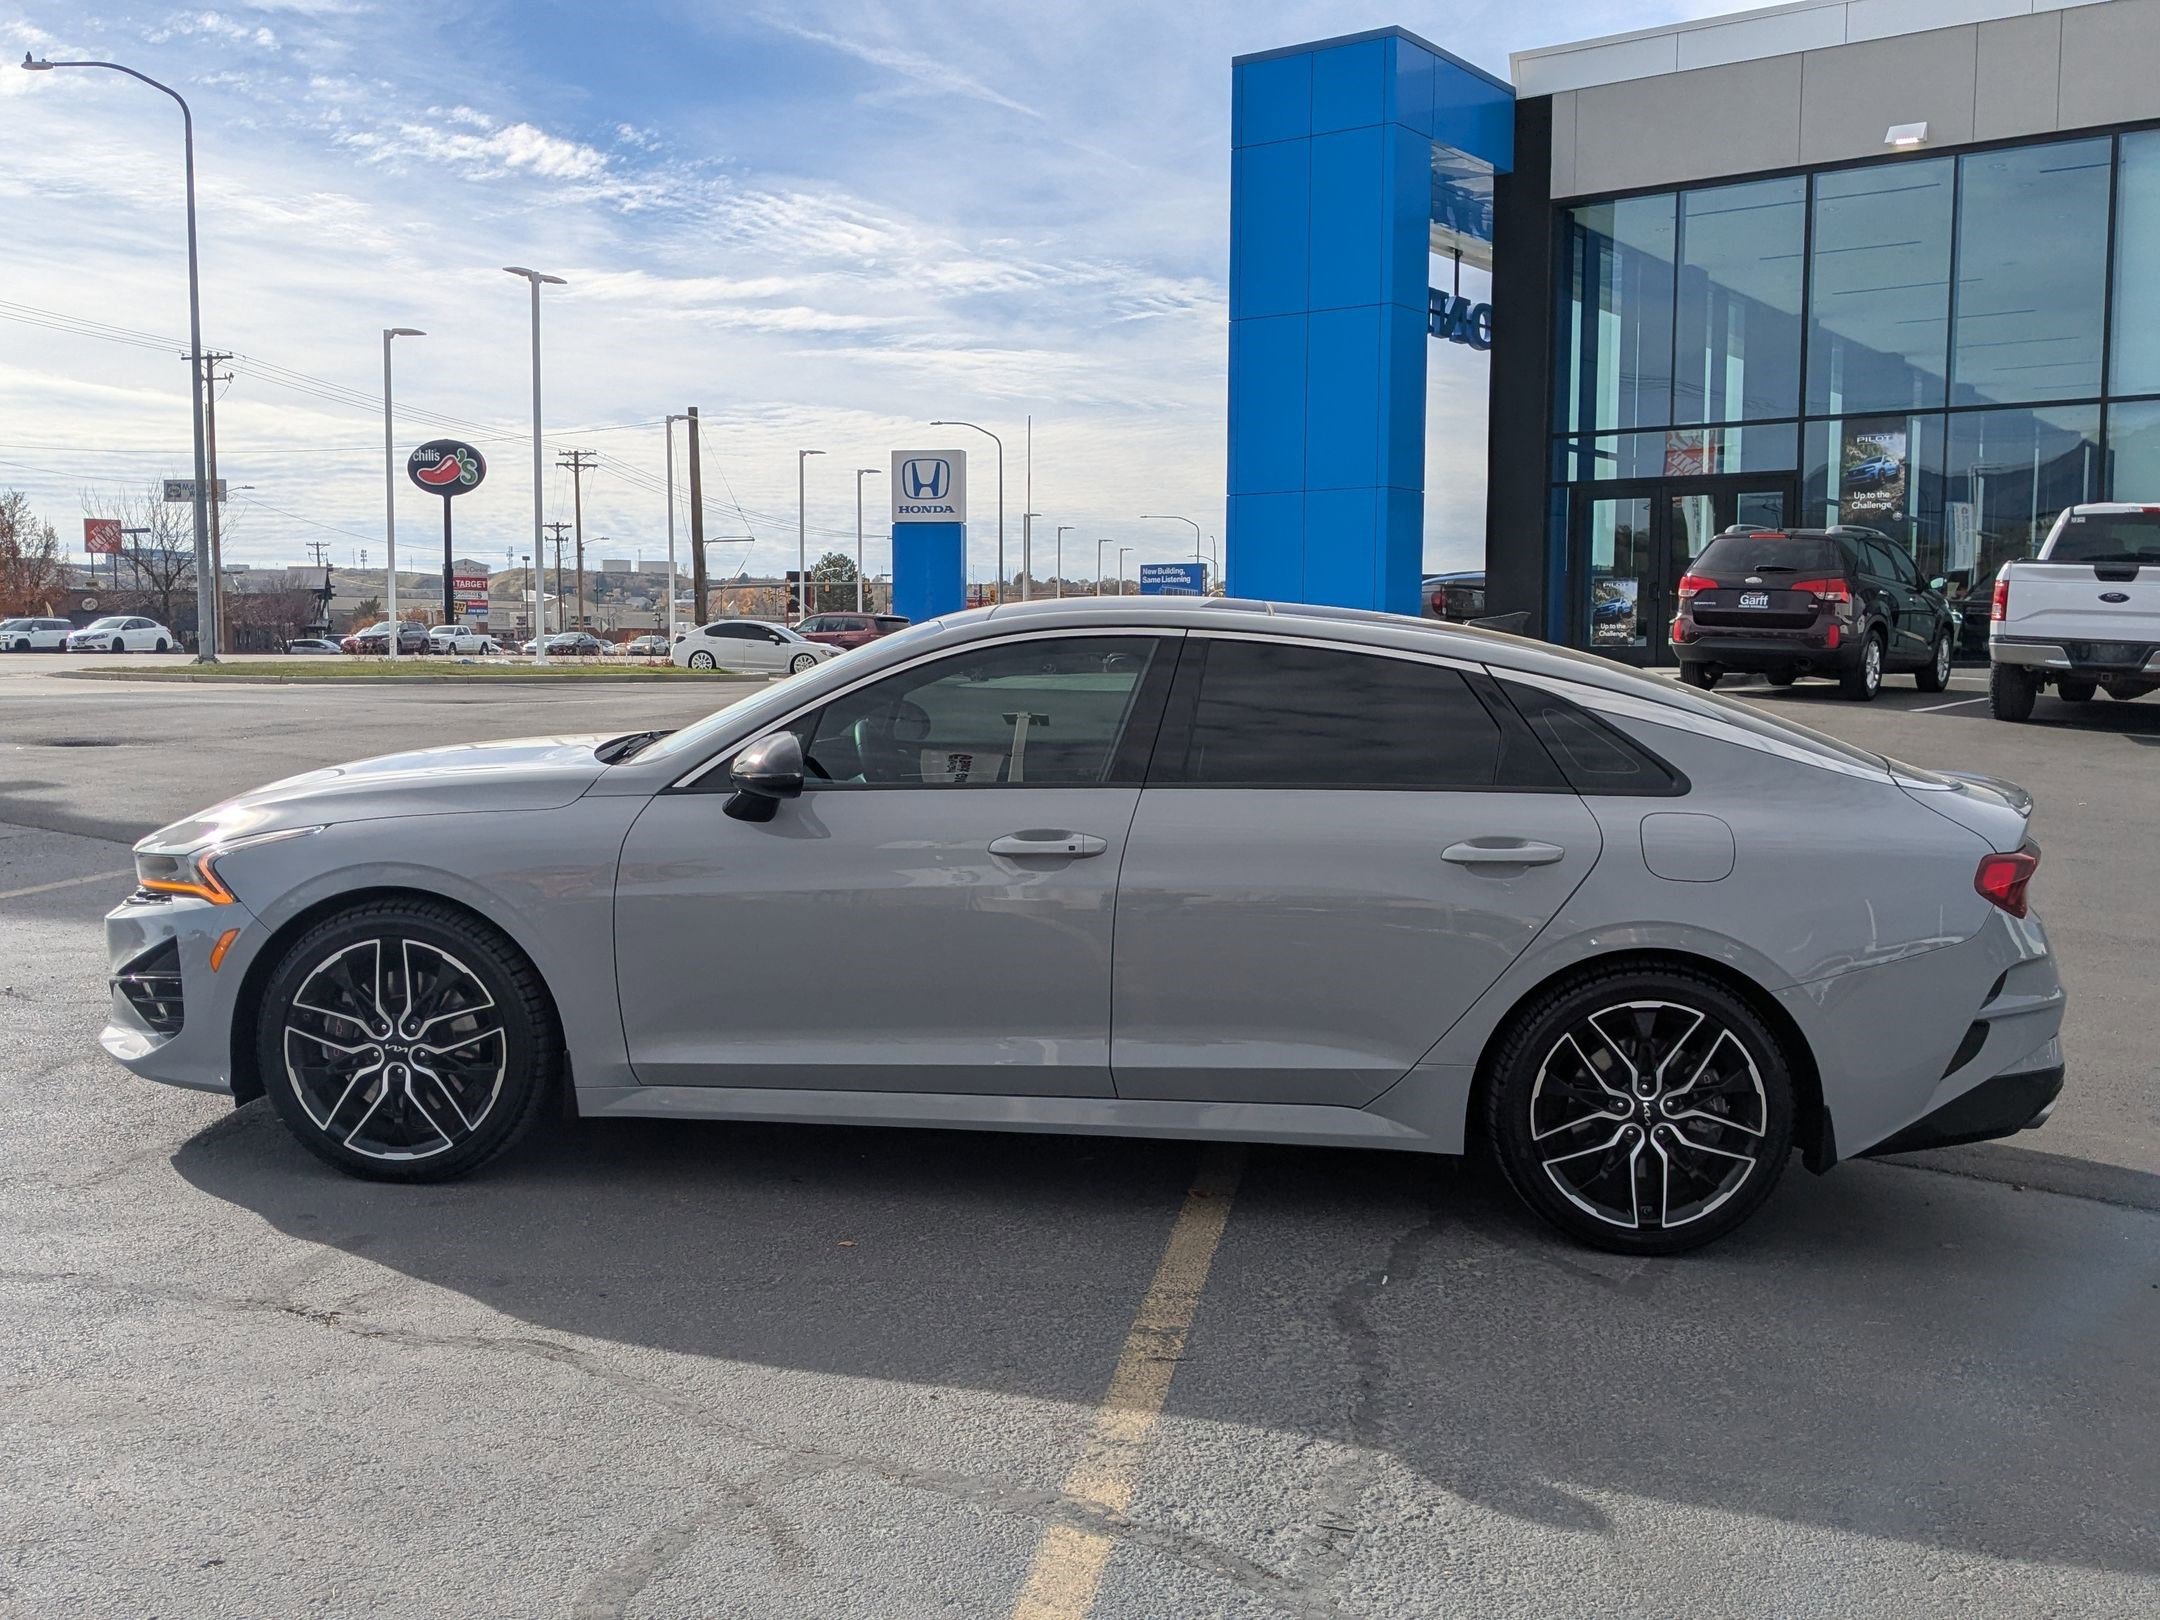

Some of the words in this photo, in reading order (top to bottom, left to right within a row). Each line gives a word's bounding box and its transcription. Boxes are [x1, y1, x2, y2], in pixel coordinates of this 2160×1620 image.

[1856, 435, 1891, 443] PILOT
[1853, 492, 1865, 500] Up
[898, 505, 955, 513] HONDA
[1851, 501, 1892, 510] Challenge
[456, 580, 486, 588] TARGET
[1161, 576, 1191, 584] Listening
[1740, 594, 1768, 605] Garff
